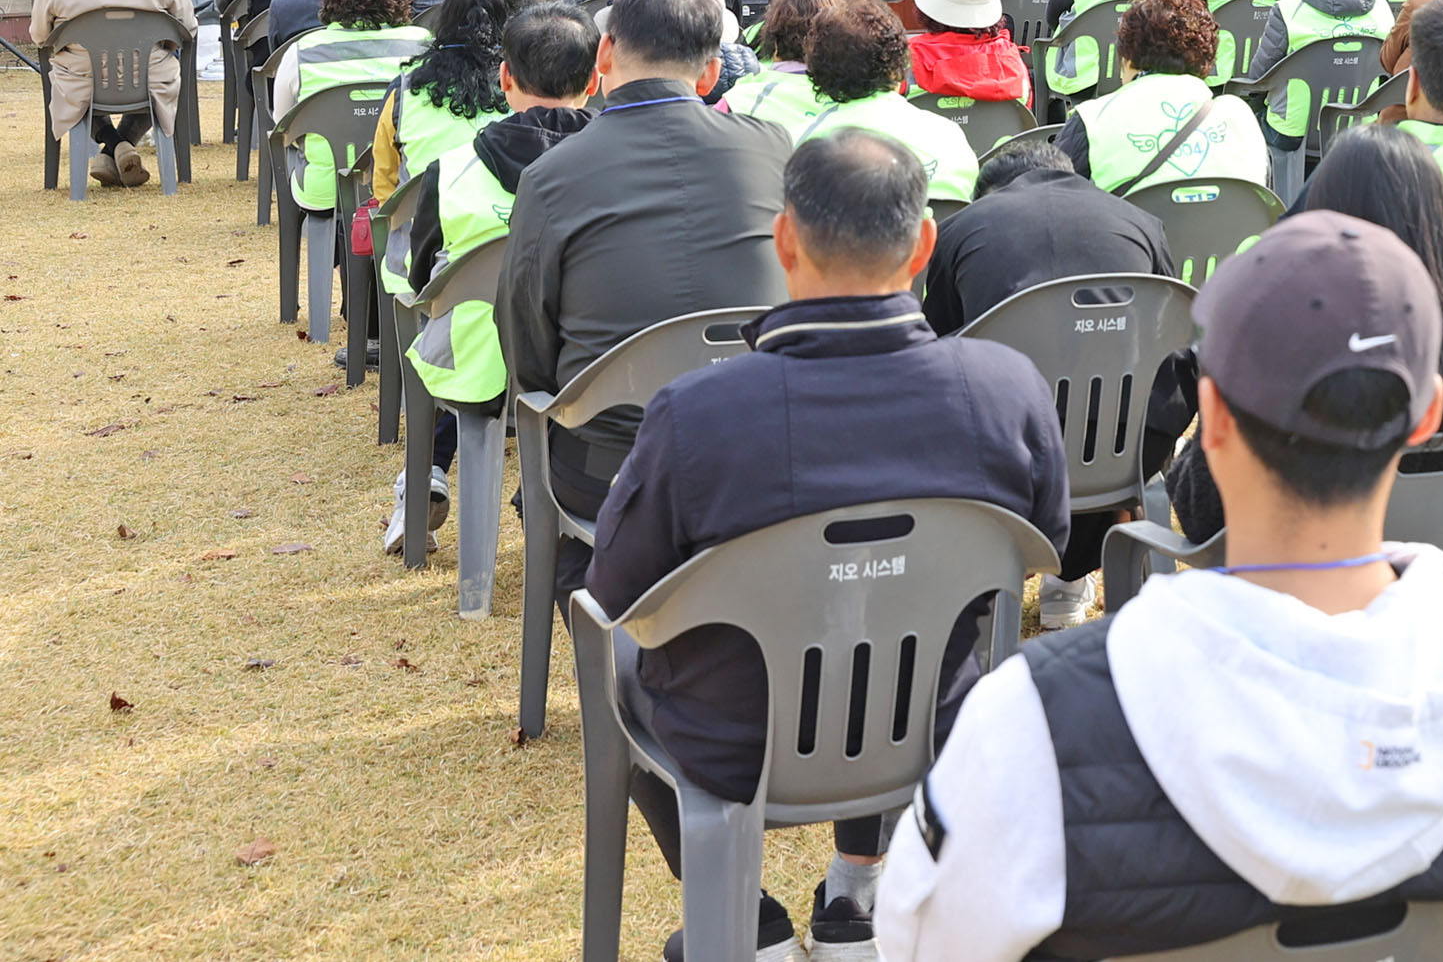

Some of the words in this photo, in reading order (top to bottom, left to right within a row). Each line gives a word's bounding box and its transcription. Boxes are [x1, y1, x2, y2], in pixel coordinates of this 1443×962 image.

[1344, 57, 1359, 65] 시스템
[354, 107, 367, 117] 지오
[367, 107, 379, 117] 시스
[1174, 141, 1203, 158] 004
[1074, 319, 1094, 333] 지오
[1096, 316, 1127, 332] 시스템
[829, 561, 859, 582] 지오
[862, 554, 906, 579] 시스템
